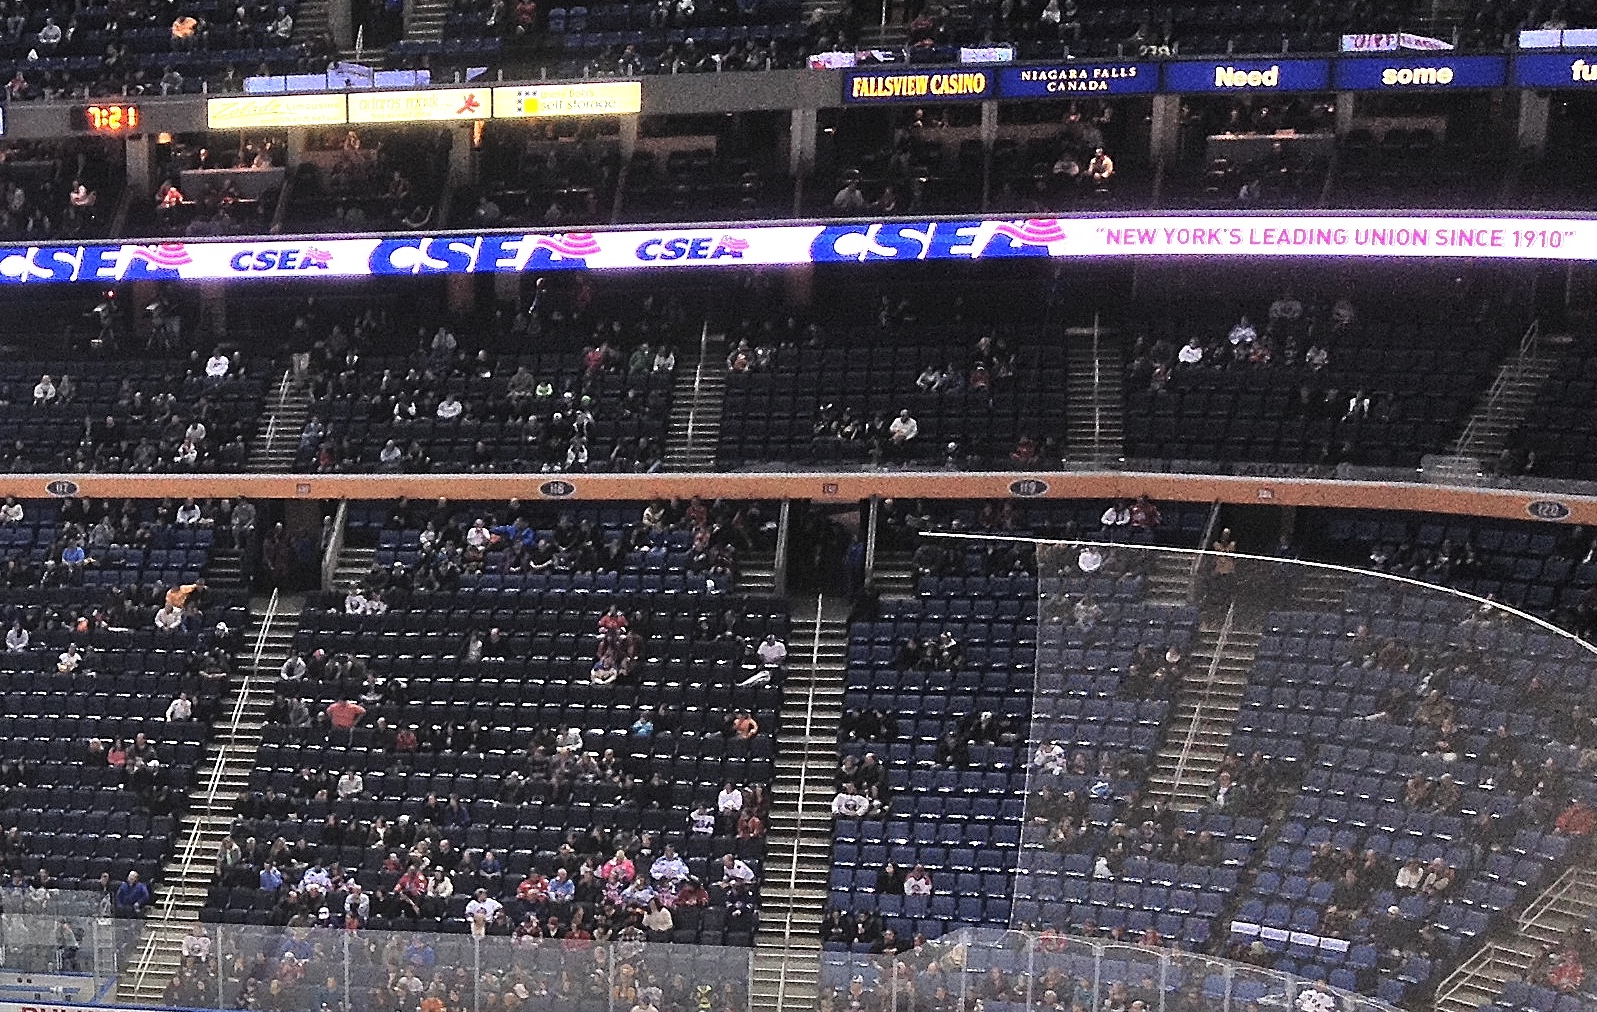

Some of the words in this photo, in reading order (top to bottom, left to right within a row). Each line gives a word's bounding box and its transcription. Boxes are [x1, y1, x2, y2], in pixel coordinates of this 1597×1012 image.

[852, 75, 929, 98] FALLSVIEW
[930, 72, 986, 96] CASINO
[1021, 69, 1089, 83] NIAGARA
[1093, 66, 1137, 79] FALLS
[1215, 65, 1279, 87] Need
[1382, 65, 1453, 85] some
[1047, 80, 1109, 93] CANADA
[86, 105, 138, 130] 7:21
[229, 246, 334, 272] CSEA
[368, 234, 592, 275] CSEA
[634, 235, 750, 261] CSEA
[808, 220, 1057, 263] CSEA
[1163, 227, 1242, 246] YORK'S
[1249, 227, 1348, 246] LEADING
[1355, 228, 1428, 247] UNION
[1435, 228, 1503, 248] SINCE
